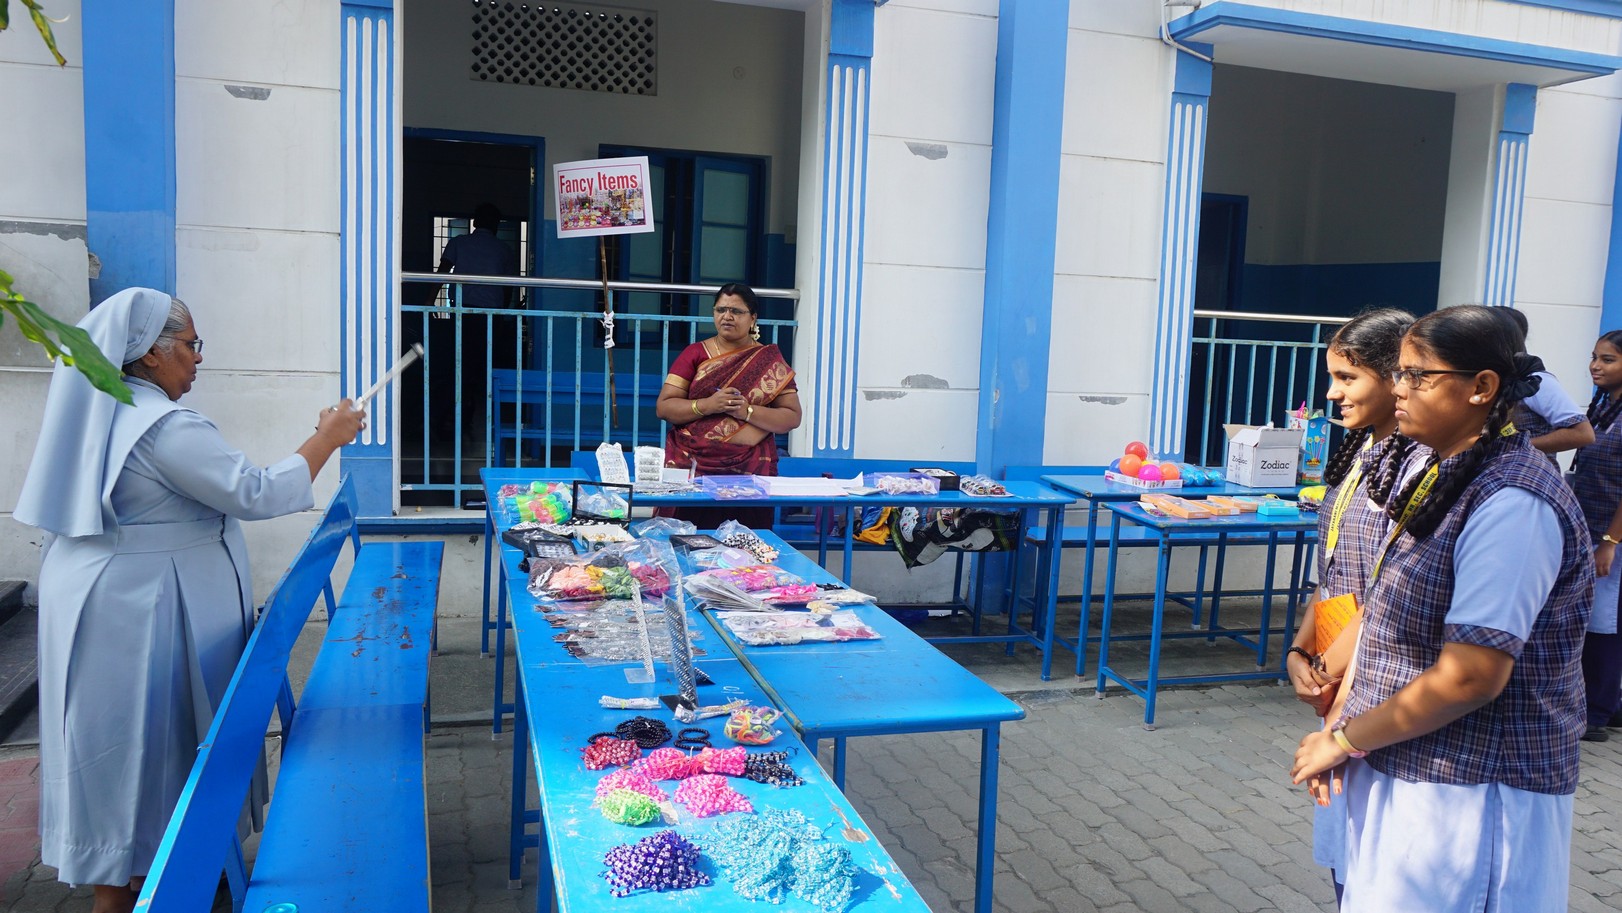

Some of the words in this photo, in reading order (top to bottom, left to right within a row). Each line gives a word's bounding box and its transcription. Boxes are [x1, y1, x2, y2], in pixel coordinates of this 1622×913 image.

[559, 175, 594, 196] Fancy
[597, 171, 638, 191] Items
[1231, 455, 1248, 465] Zodiac
[1260, 460, 1290, 470] Zodiac
[1413, 491, 1425, 503] SEC.
[1420, 472, 1437, 491] SCHOOL
